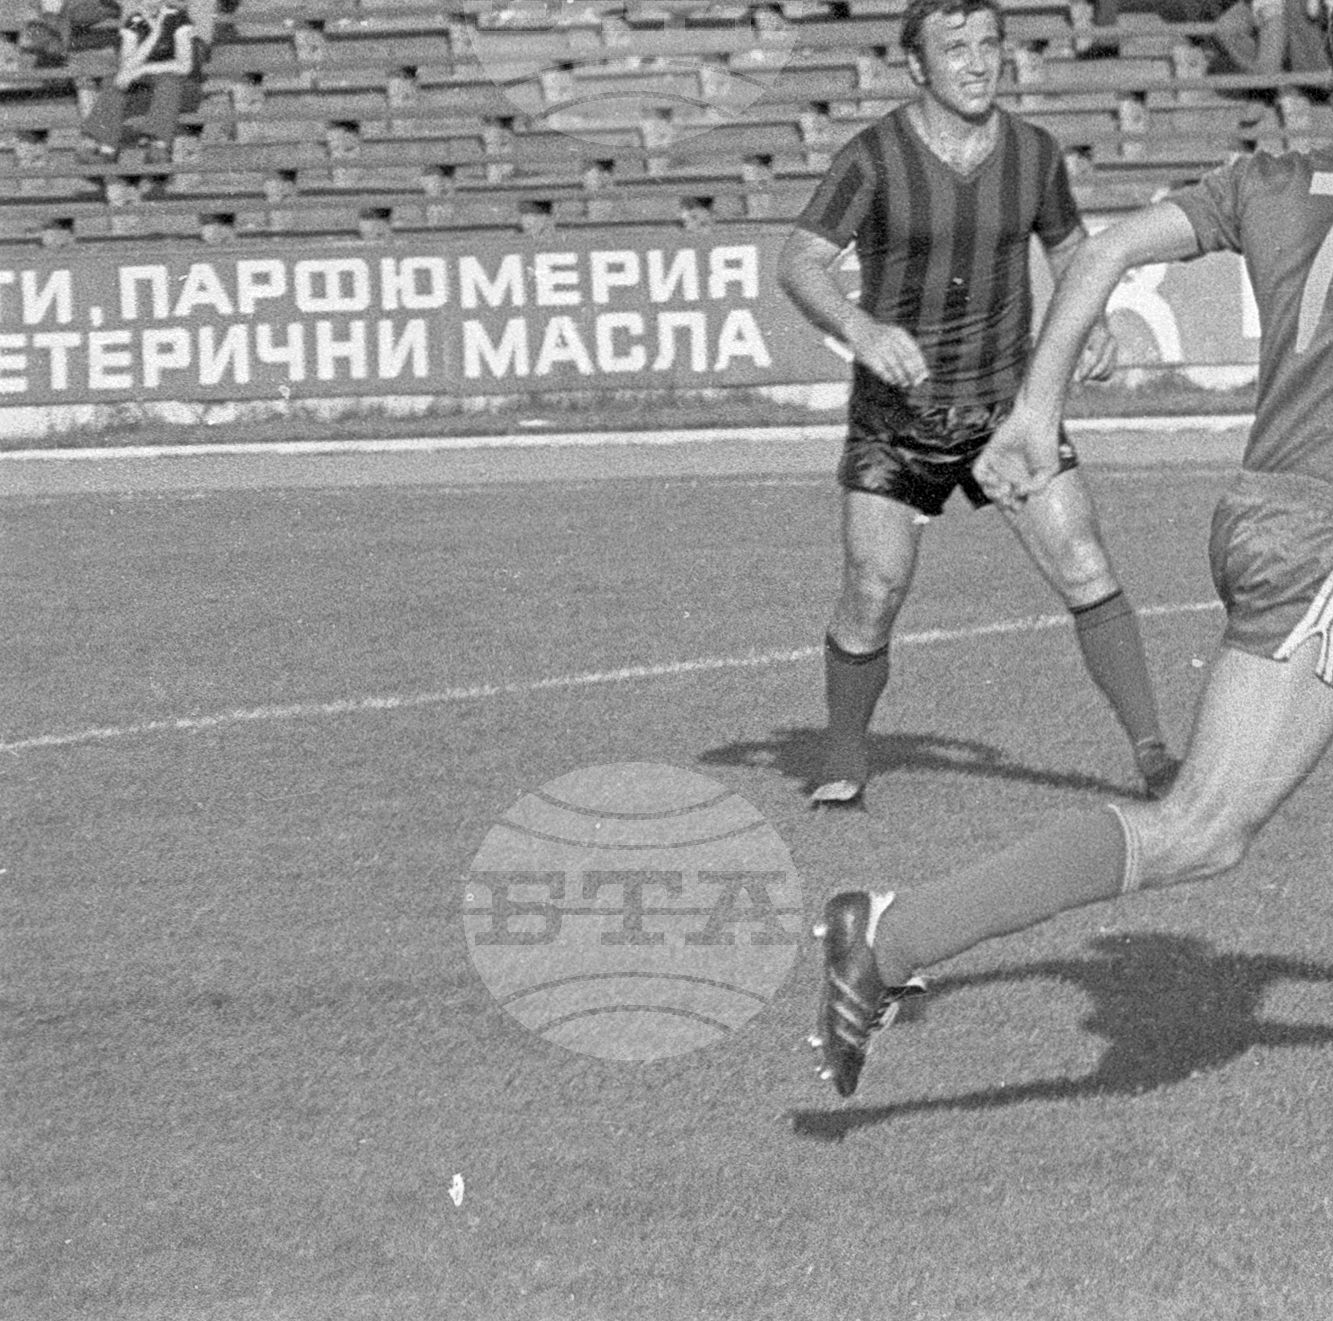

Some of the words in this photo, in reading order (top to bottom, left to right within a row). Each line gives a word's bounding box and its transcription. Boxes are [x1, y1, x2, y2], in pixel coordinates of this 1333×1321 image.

[0, 268, 104, 327] И,
[118, 244, 761, 320] ПАРФЮМЕРИЯ
[462, 309, 772, 378] МАСЛА
